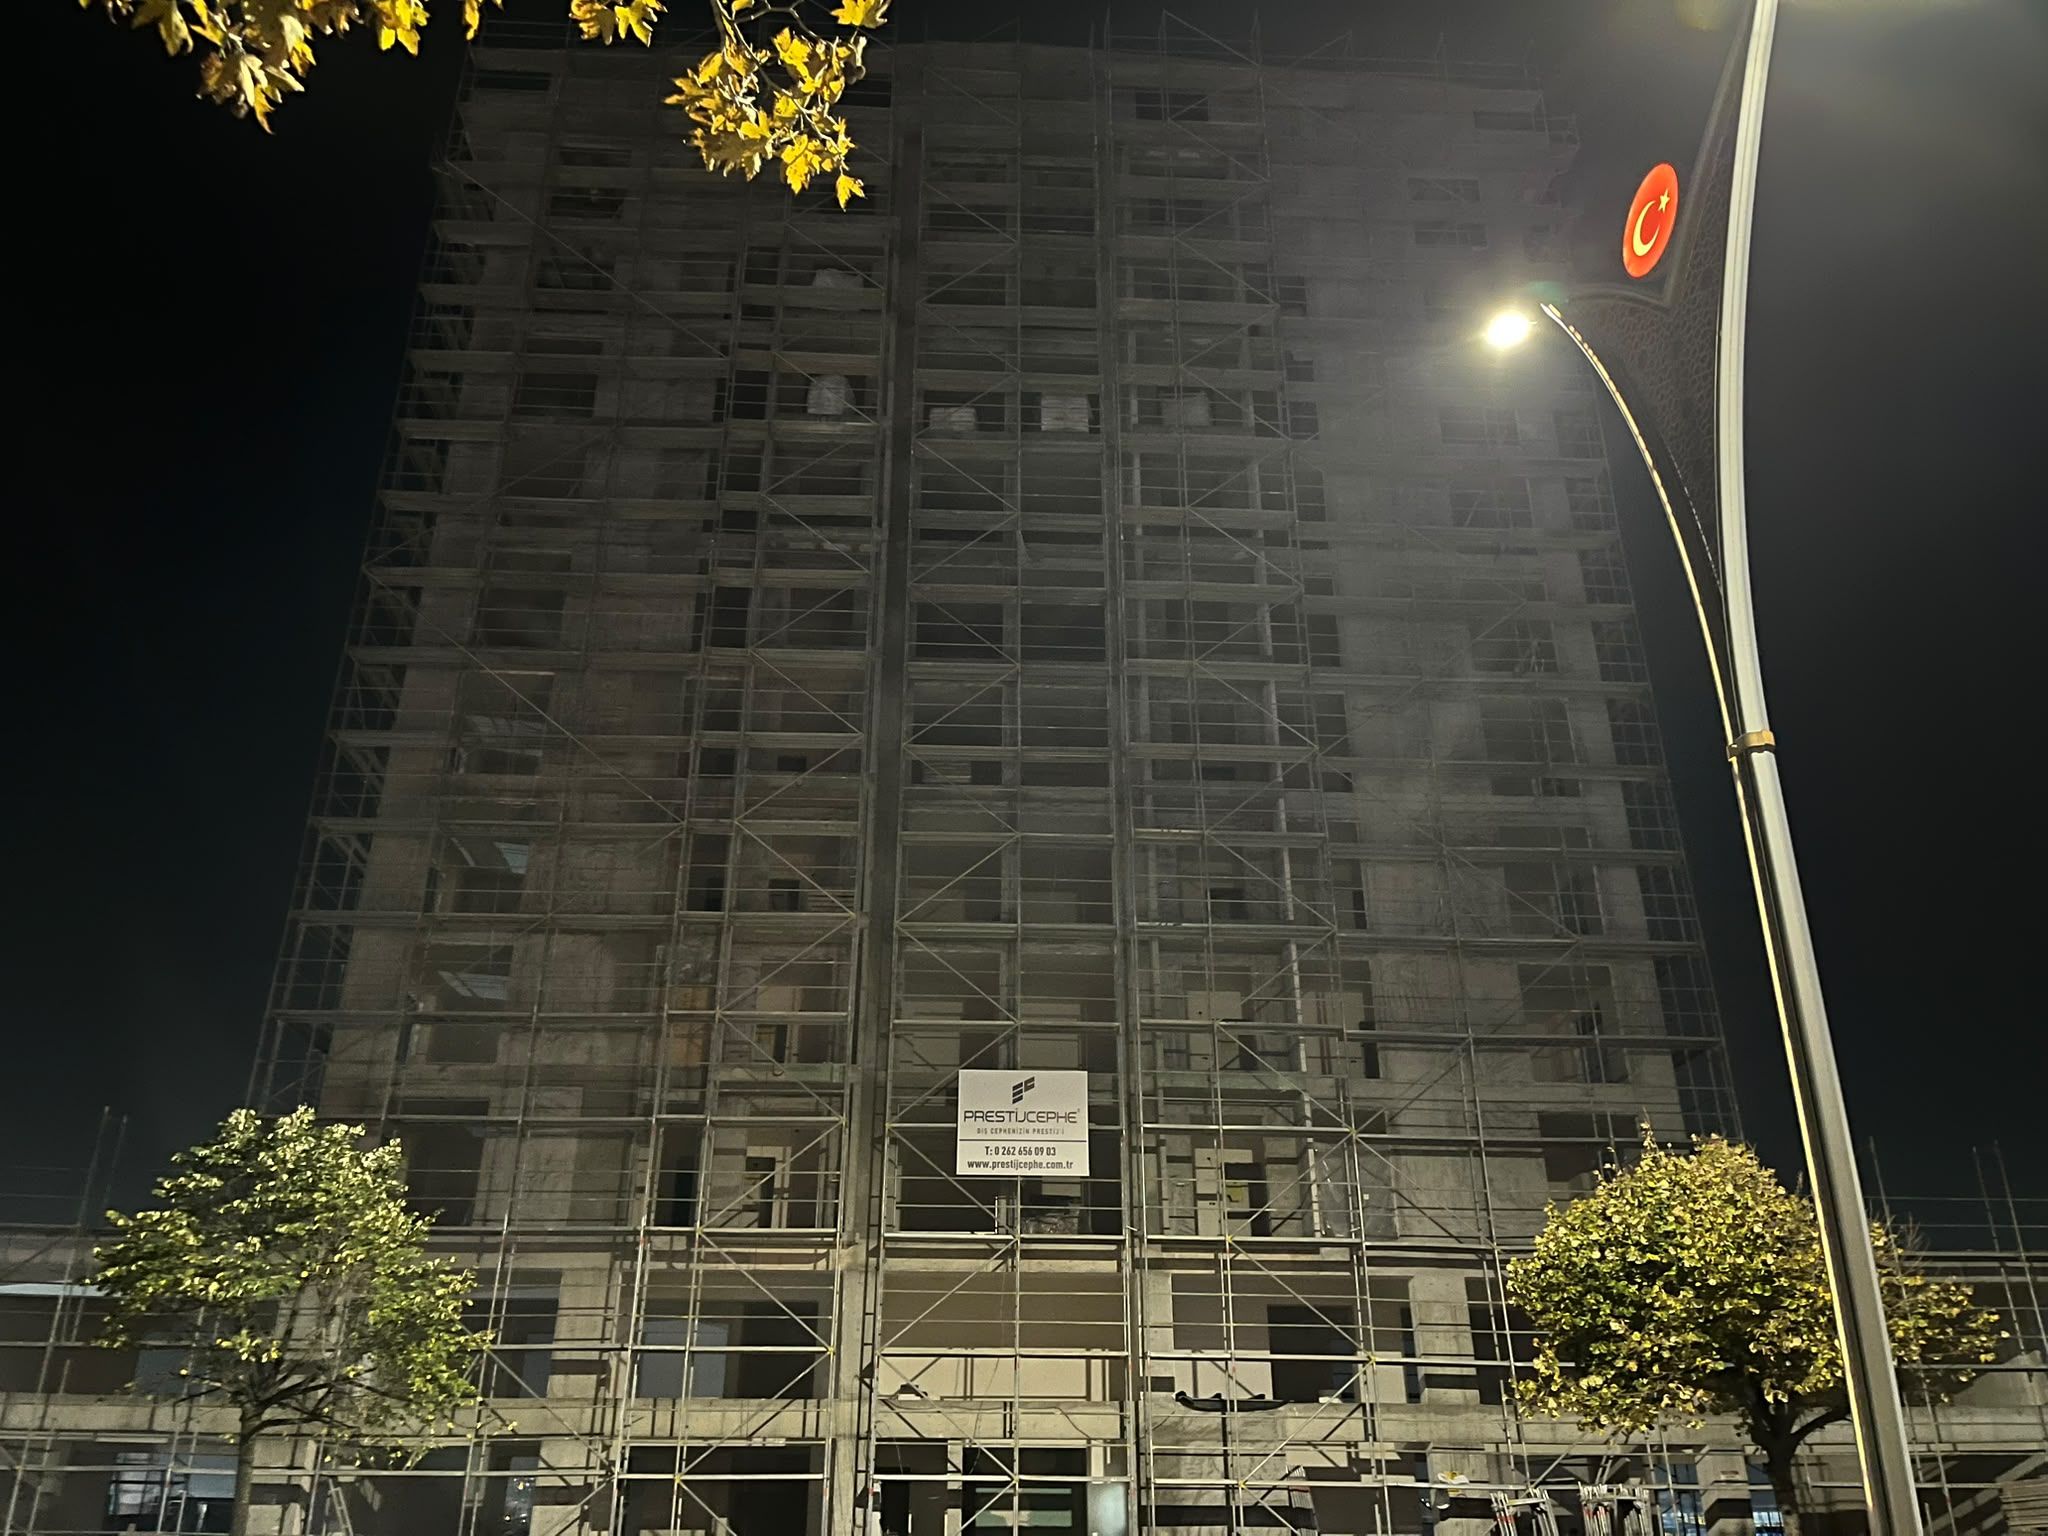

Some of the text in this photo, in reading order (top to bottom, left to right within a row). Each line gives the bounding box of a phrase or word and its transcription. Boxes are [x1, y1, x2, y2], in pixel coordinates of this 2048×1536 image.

[985, 1146, 1056, 1156] T: 0 262 656 09 03
[967, 1160, 1073, 1170] www.prestijcephe.com.tr
